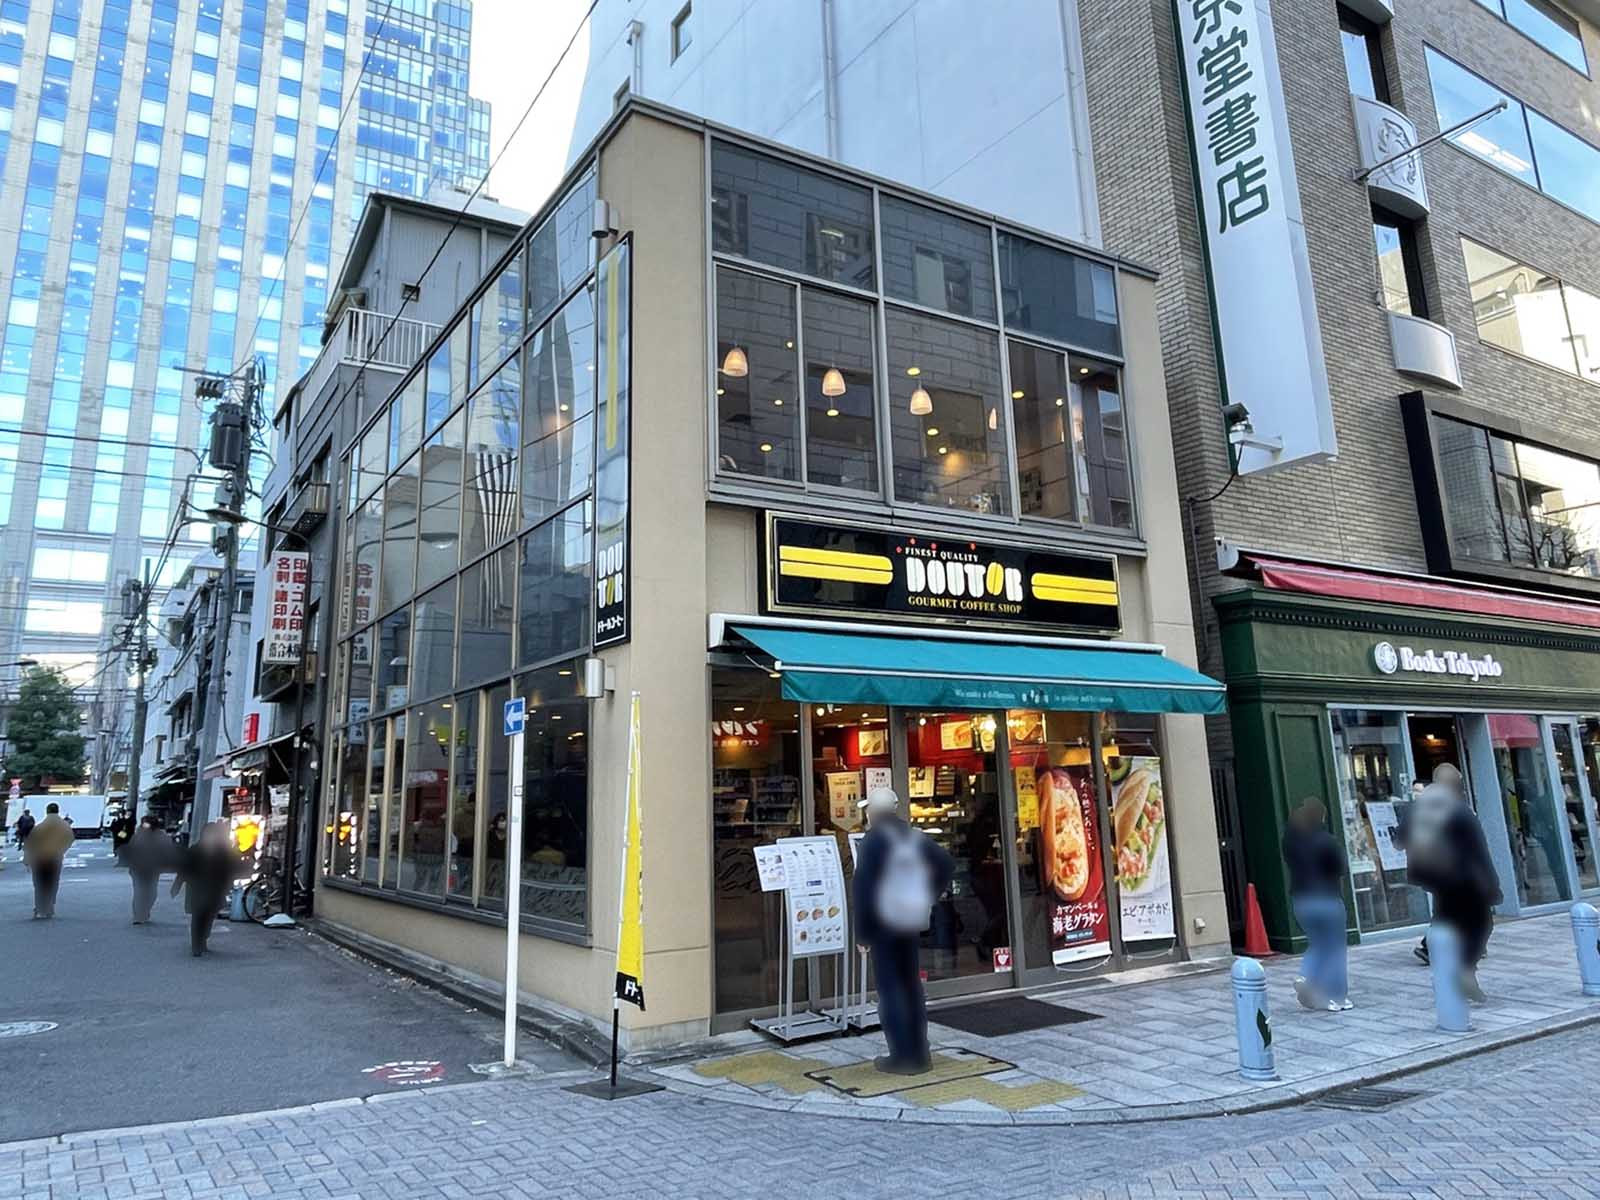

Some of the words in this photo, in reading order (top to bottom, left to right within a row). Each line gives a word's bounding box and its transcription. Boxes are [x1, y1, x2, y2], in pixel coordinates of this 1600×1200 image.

[905, 547, 937, 558] FINEST
[940, 551, 979, 562] QUALITY
[905, 556, 1023, 602] DOUTOR
[908, 595, 957, 609] GOURMET
[960, 600, 996, 611] COFFEE
[998, 603, 1022, 614] SHOP
[1399, 646, 1447, 673] Books
[1443, 650, 1502, 682] Tokyodo
[1052, 912, 1105, 935] 海老グラタン
